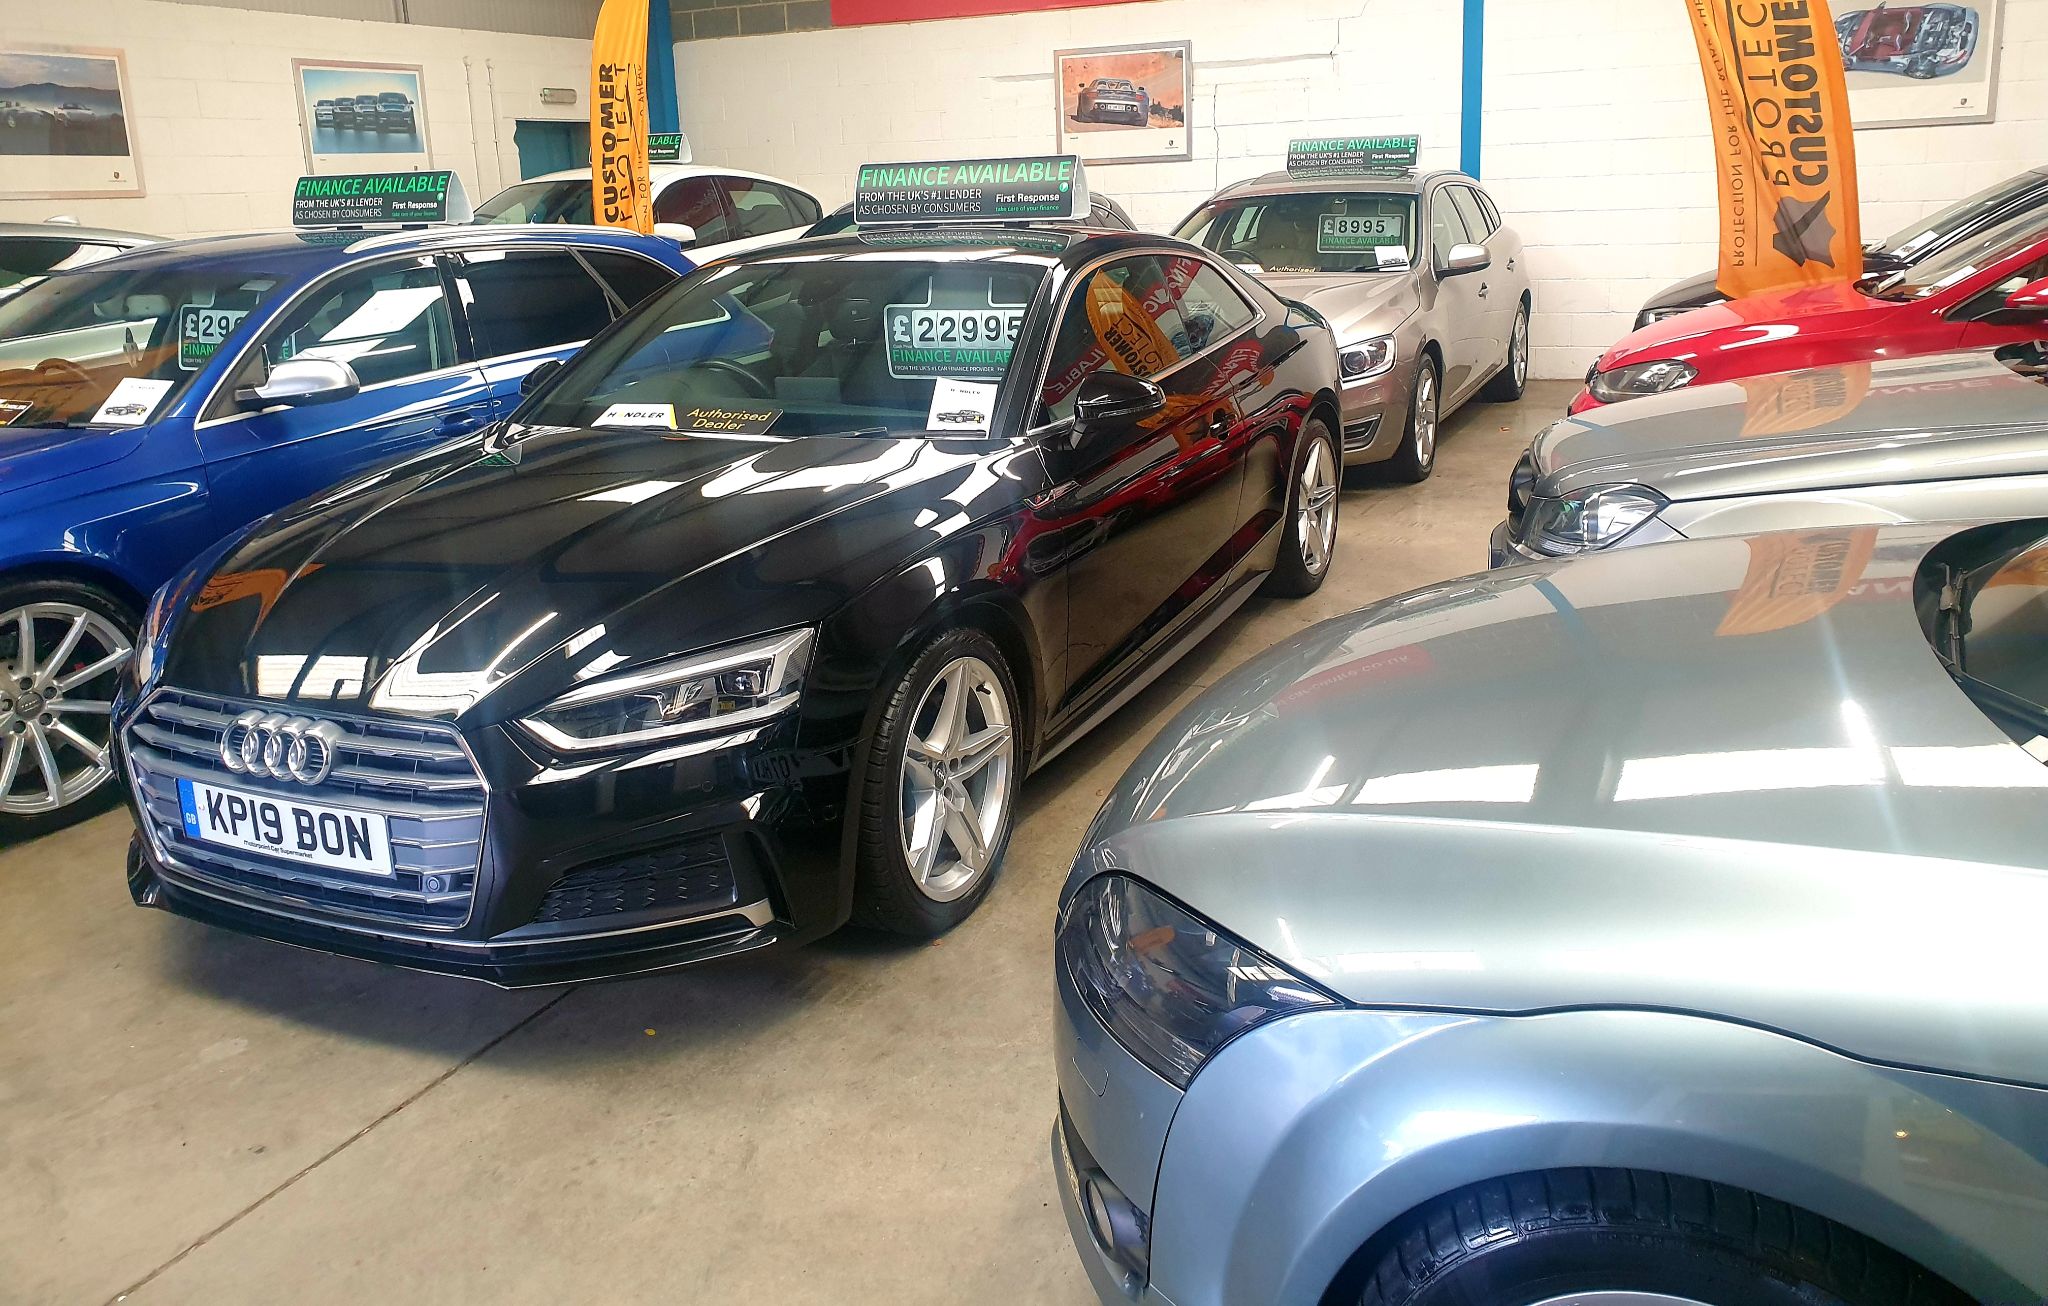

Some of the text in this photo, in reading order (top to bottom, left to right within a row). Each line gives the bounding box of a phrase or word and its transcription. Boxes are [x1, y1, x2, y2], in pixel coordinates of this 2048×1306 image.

[600, 63, 620, 224] CUSTOMER
[648, 136, 680, 145] ILABLE
[1290, 137, 1417, 152] FINANCE AVAILABLE
[1328, 158, 1364, 166] CONSUMERS
[860, 161, 1072, 188] FINANCE AVAILABLE
[297, 175, 448, 197] FINANCE AVAILABLE
[859, 189, 982, 202] FROM THE UK'S #1 LENDER
[996, 193, 1060, 203] First Response
[296, 198, 383, 209] FROM THE UK'S #1 LENDER
[392, 200, 438, 210] First Response
[858, 202, 981, 215] AS CHOSEN BY CONSUMERS
[294, 208, 382, 219] AS CHOSEN BY CONSUMERS
[1324, 220, 1386, 234] £8995
[1269, 265, 1316, 273] Authorised
[892, 314, 1023, 343] £22995
[184, 345, 217, 356] FINAN
[892, 350, 951, 362] FINANCE
[686, 408, 772, 422] Authorised
[692, 418, 746, 430] Dealer
[186, 812, 197, 825] GB
[206, 789, 373, 861] KP19 BON
[270, 845, 280, 854] Car
[280, 848, 313, 858] Supermarket
